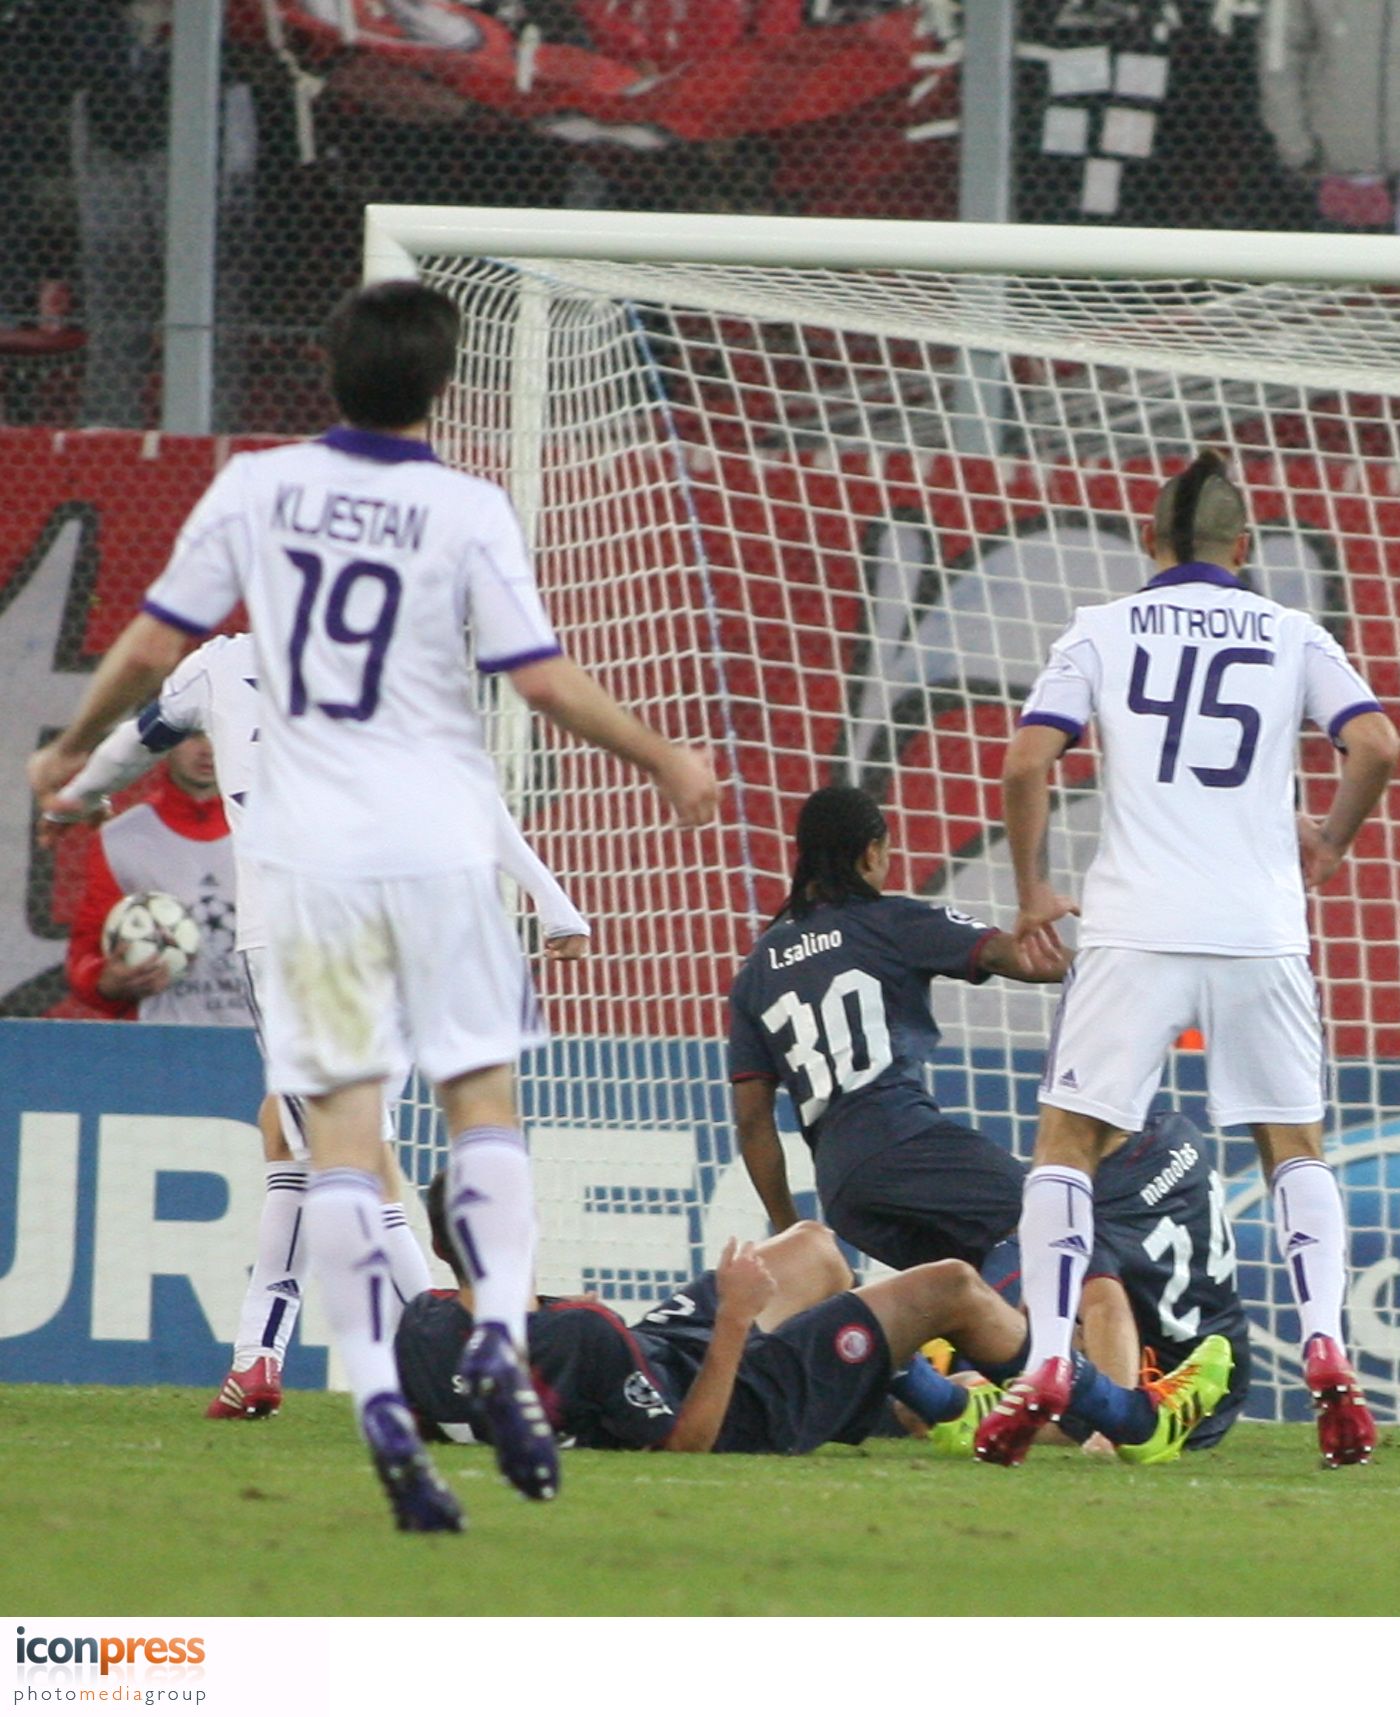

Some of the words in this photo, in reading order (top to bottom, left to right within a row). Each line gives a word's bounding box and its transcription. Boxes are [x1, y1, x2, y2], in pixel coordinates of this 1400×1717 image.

[270, 482, 429, 552] KLJESTAN
[281, 546, 404, 722] 19
[1130, 603, 1273, 643] MITROVIC
[1127, 643, 1276, 789] 45
[760, 968, 893, 1128] 30
[1139, 1142, 1199, 1207] manolas
[1141, 1169, 1237, 1342] 24
